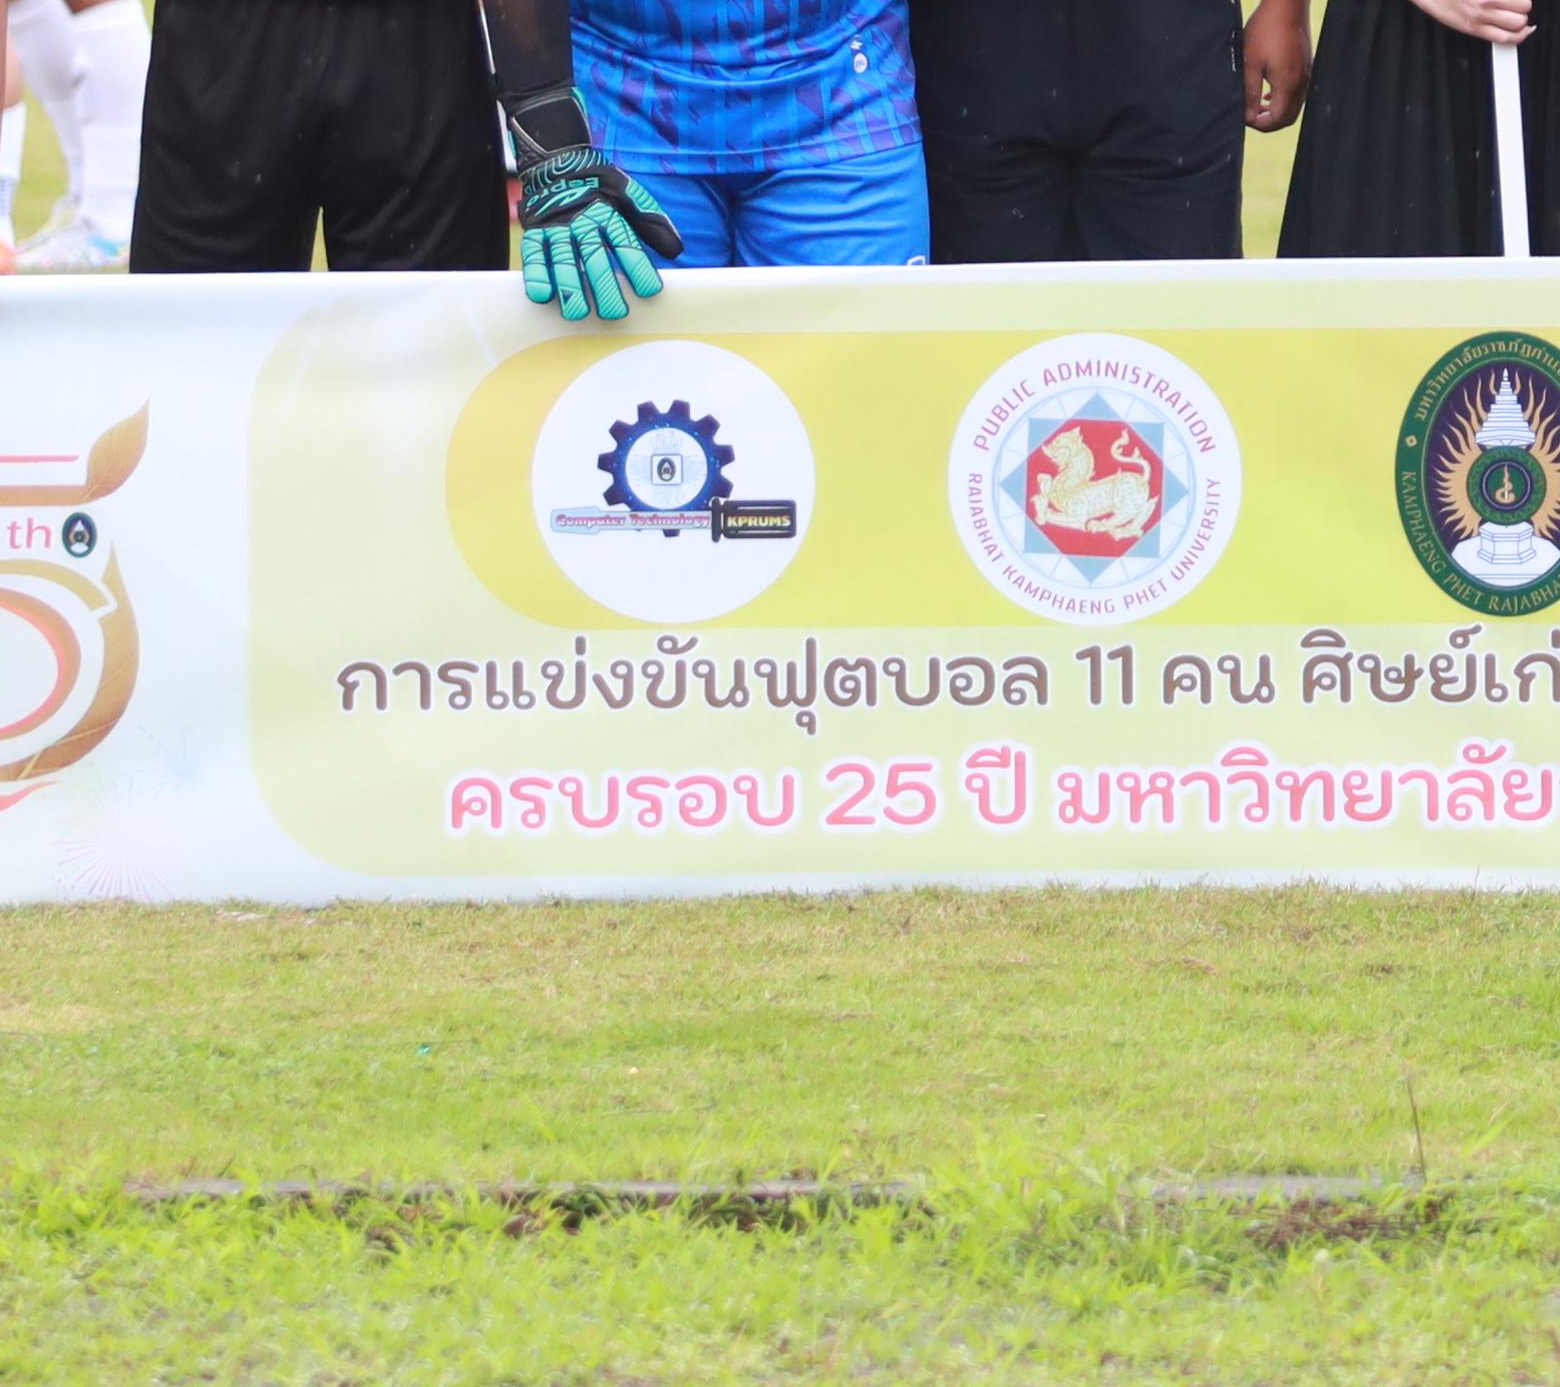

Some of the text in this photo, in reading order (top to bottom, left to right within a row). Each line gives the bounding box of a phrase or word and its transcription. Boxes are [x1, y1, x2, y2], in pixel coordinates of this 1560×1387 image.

[973, 359, 1216, 454] PUBLIC ADMINISTRATION
[555, 512, 791, 529] Computer Technology KPRUMS
[1002, 563, 1116, 615] KAMPHAENG
[1123, 578, 1169, 610] PHET
[1169, 478, 1221, 582] UNIVERSITY
[1402, 471, 1447, 575] KAMPHAENG
[1443, 574, 1486, 606] PHET
[336, 636, 1048, 735] การแข่งขันฟุตบอล
[1075, 645, 1134, 706] 11
[1162, 654, 1275, 705] คน
[450, 773, 795, 830] ครบรอบ
[825, 761, 938, 826] 25
[965, 745, 1026, 826] ปี
